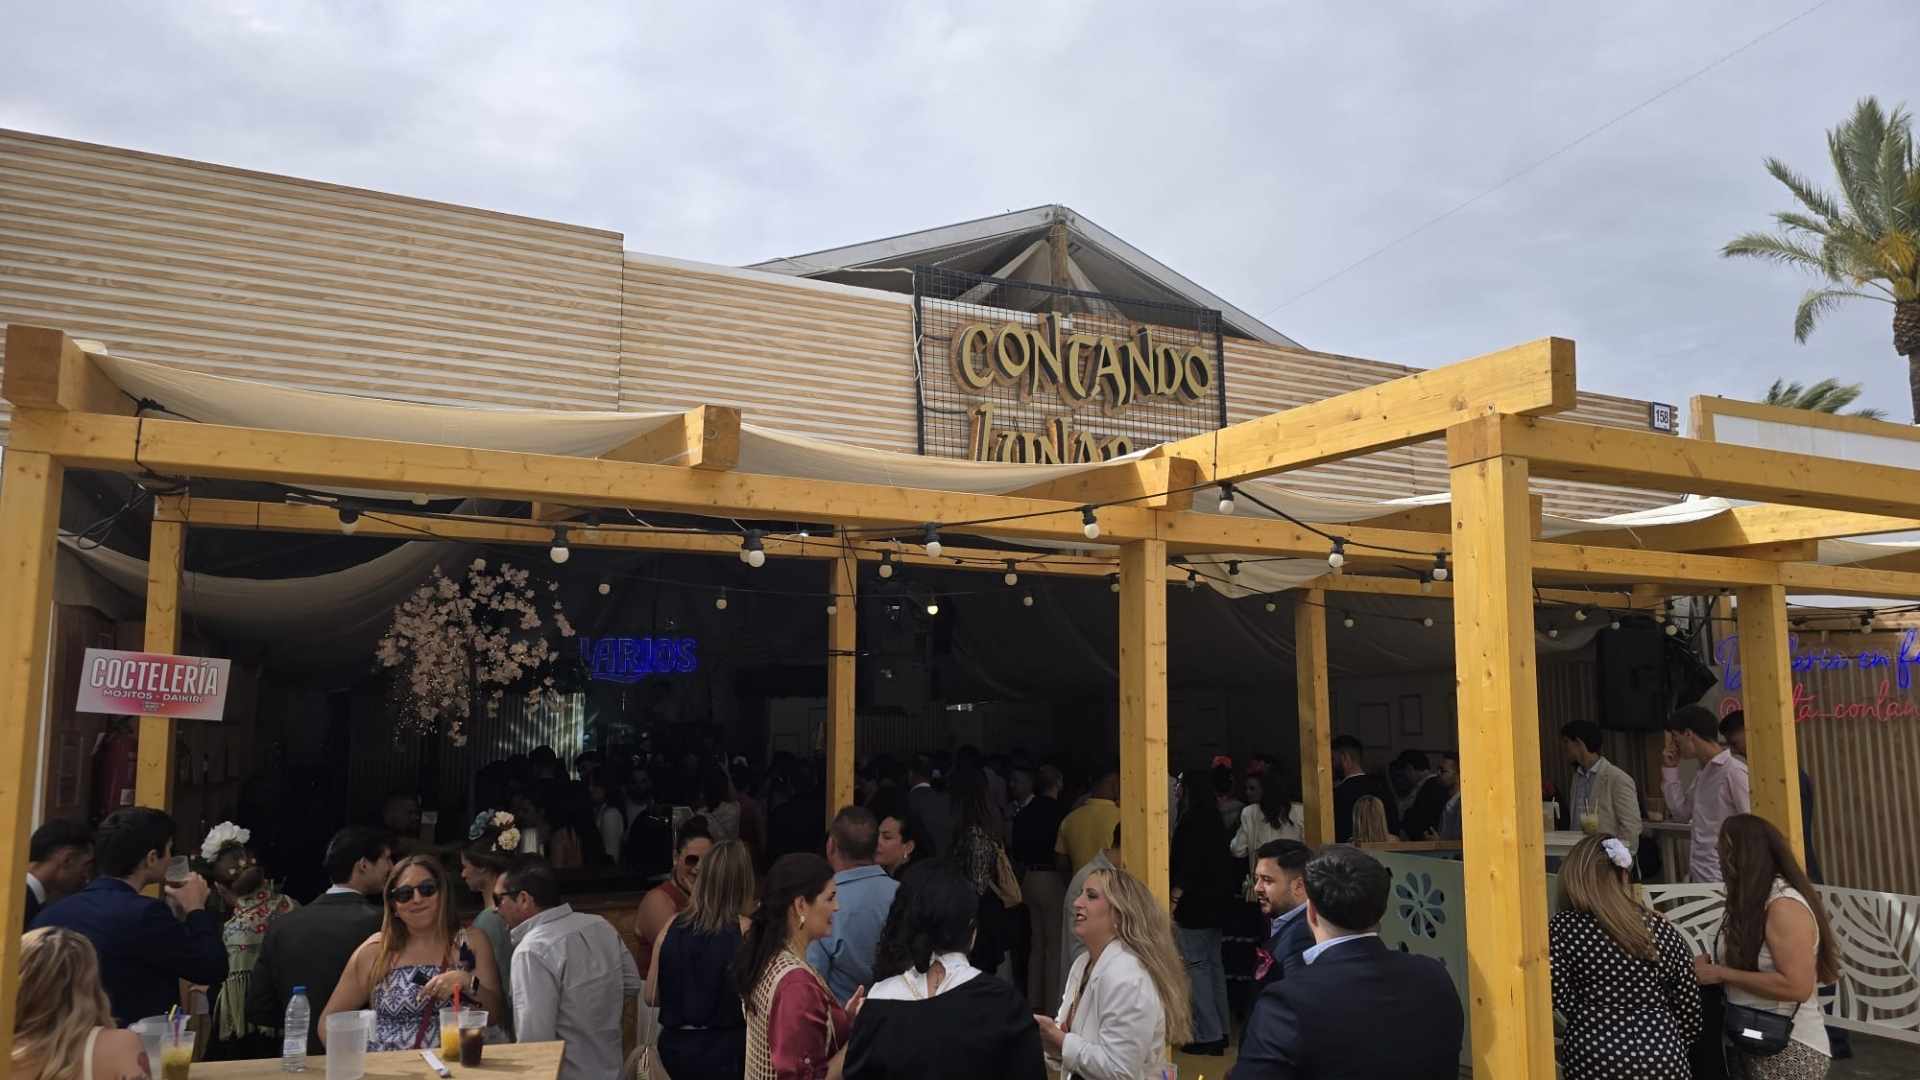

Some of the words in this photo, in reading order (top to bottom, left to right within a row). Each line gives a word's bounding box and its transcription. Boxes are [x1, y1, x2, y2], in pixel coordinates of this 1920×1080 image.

[955, 311, 1214, 407] CONTANDO
[90, 658, 218, 696] COCTELERÍA
[103, 689, 153, 700] MOJITOS
